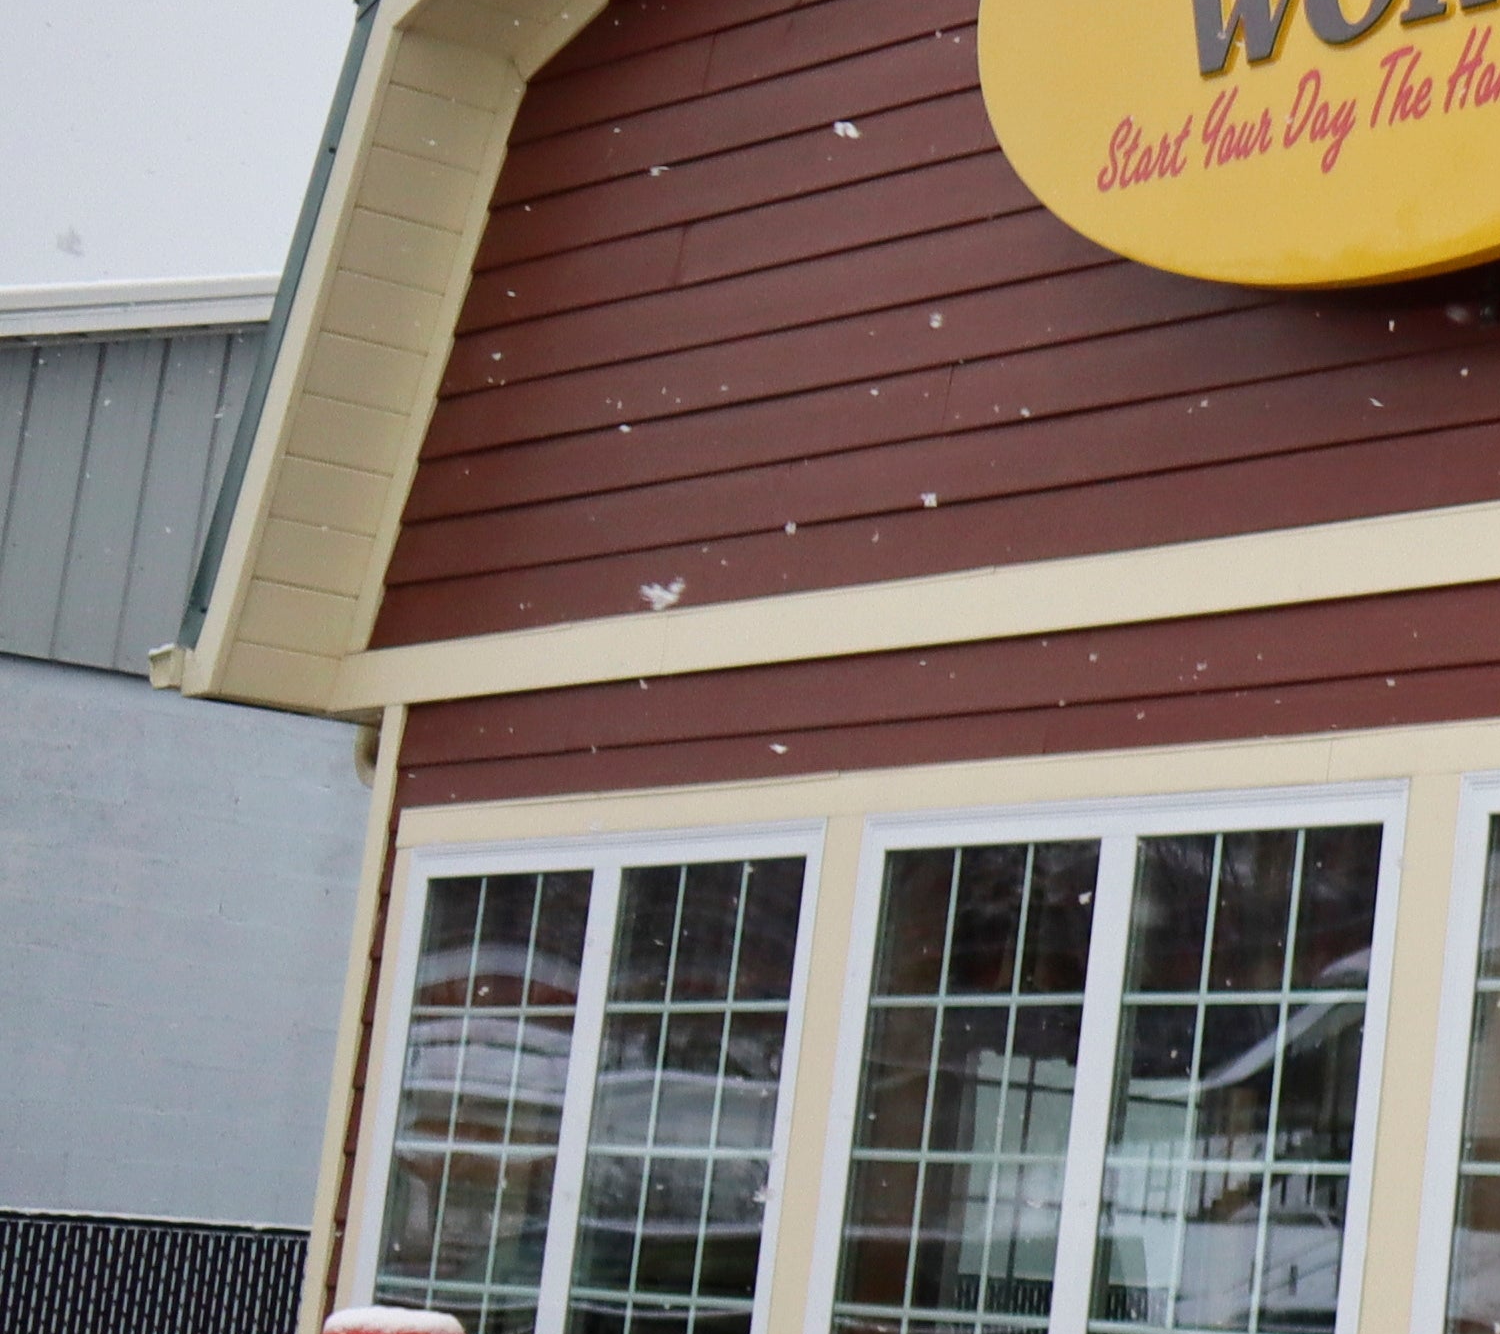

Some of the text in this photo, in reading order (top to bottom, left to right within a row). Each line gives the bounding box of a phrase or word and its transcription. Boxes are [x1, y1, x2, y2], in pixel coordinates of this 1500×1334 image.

[1097, 114, 1192, 193] Start
[1201, 86, 1274, 167] Your
[1283, 68, 1356, 174] Day
[1370, 44, 1432, 130] The
